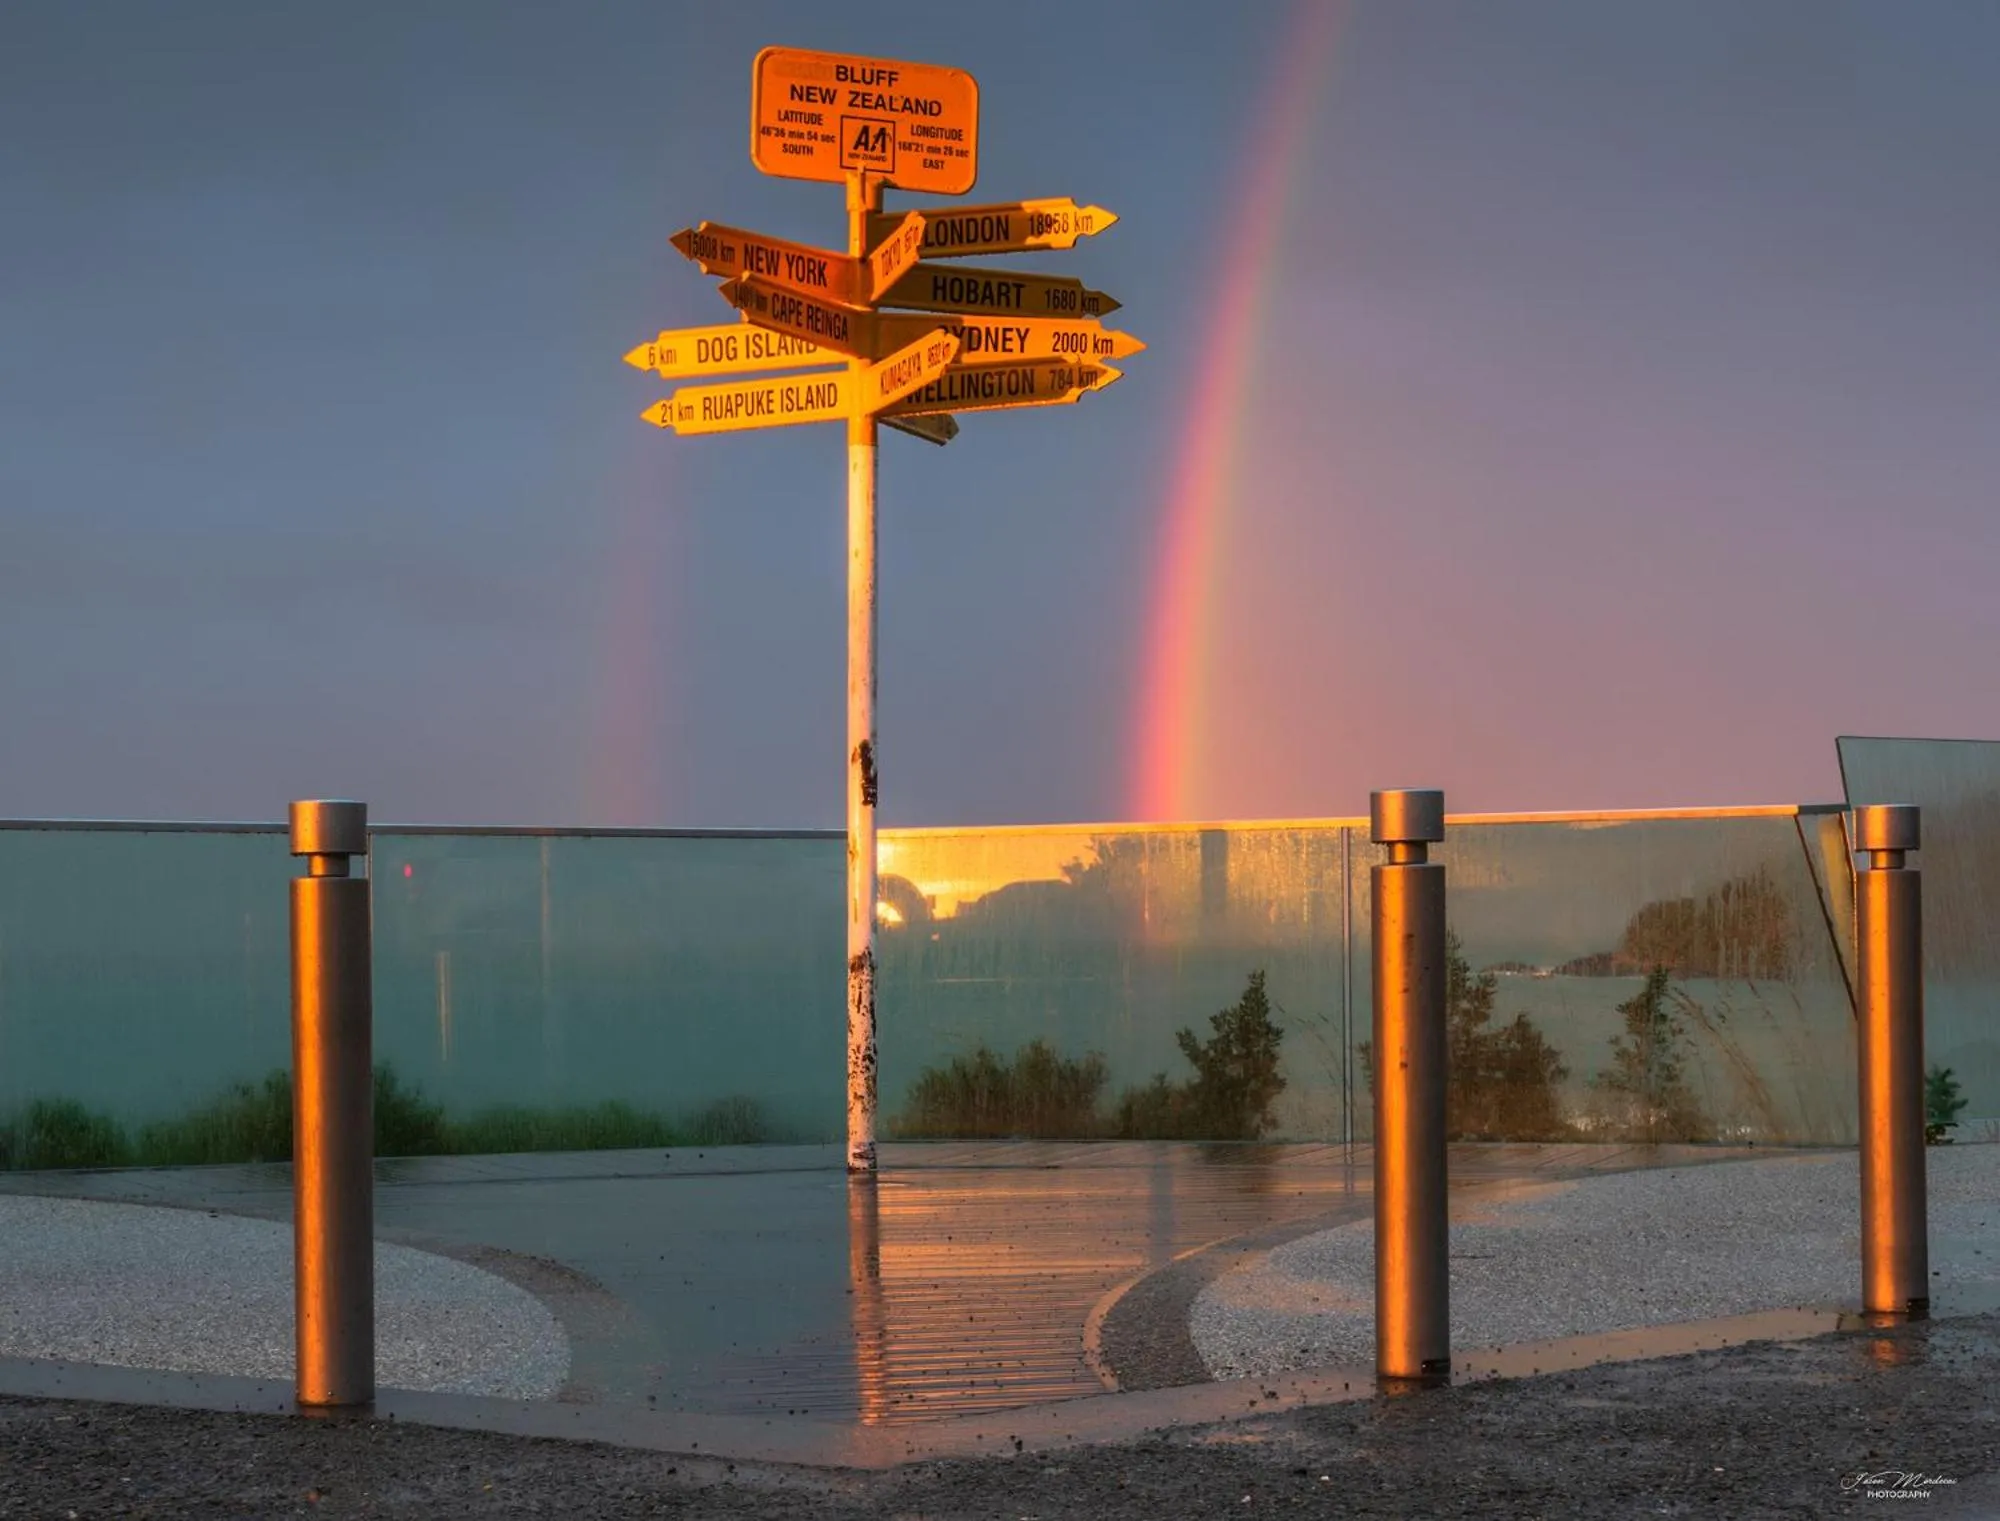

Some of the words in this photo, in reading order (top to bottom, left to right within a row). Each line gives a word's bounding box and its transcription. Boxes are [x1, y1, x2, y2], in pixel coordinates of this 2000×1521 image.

[835, 64, 899, 87] BLUFF
[789, 83, 837, 105] NEW
[848, 90, 942, 117] ZEALAND
[777, 109, 824, 126] LATITUDE
[910, 123, 963, 142] LONGITUDE
[782, 142, 814, 156] SOUTH
[922, 158, 945, 170] EAST
[924, 215, 1010, 247] LONDON
[1029, 213, 1069, 236] 18958
[1074, 212, 1093, 233] km
[720, 240, 735, 264] km
[743, 243, 780, 277] NEW
[785, 256, 828, 288] YORK
[932, 275, 1026, 309] HOBART
[1080, 293, 1100, 313] km
[771, 292, 803, 328] CAPE
[807, 303, 850, 342] REINGA
[648, 346, 656, 366] 6
[660, 347, 677, 365] km
[697, 336, 738, 363] DOG
[1052, 331, 1088, 354] 2000
[1093, 334, 1113, 354] km
[1049, 368, 1074, 391] 784
[1078, 366, 1098, 388] km
[661, 403, 673, 423] 21
[678, 401, 694, 421] km
[703, 389, 775, 421] RUAPUKE
[780, 382, 838, 413] ISLAND
